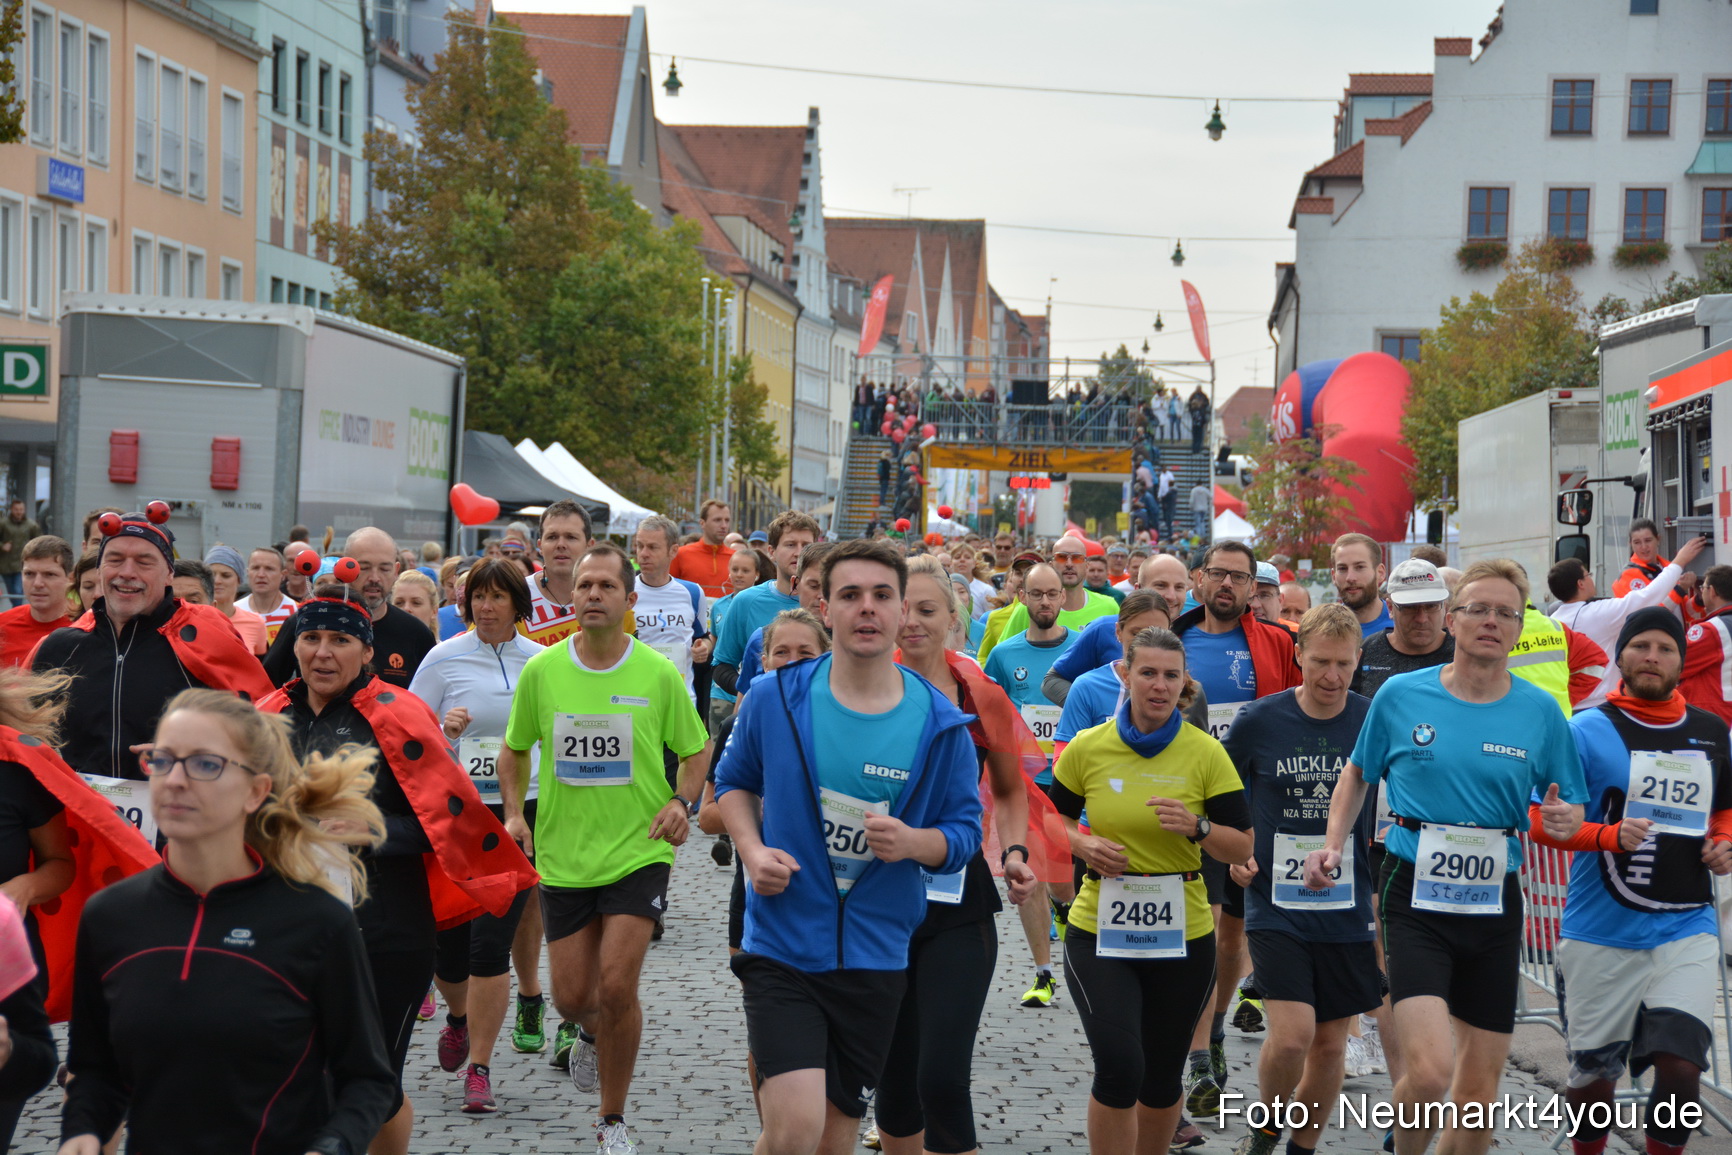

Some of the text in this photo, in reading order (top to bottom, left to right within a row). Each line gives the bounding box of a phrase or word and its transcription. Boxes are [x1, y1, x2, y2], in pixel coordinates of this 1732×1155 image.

[4, 351, 41, 388] D
[1606, 392, 1639, 448] BOCK
[408, 410, 449, 478] BOCK
[1009, 451, 1053, 468] ZIEL
[636, 613, 686, 629] SUSPA
[564, 736, 620, 757] 2193
[1482, 742, 1528, 759] BOCK
[579, 765, 605, 773] Martin
[1663, 761, 1691, 771] BOCK
[1640, 775, 1700, 806] 2152
[829, 801, 864, 817] BOCK
[1283, 809, 1299, 818] NZA
[1302, 809, 1319, 819] SEA
[1652, 808, 1683, 822] Markus
[1430, 852, 1495, 880] 2900
[1431, 883, 1489, 904] Stefan
[1111, 901, 1173, 927] 2484
[1125, 934, 1158, 943] Monika
